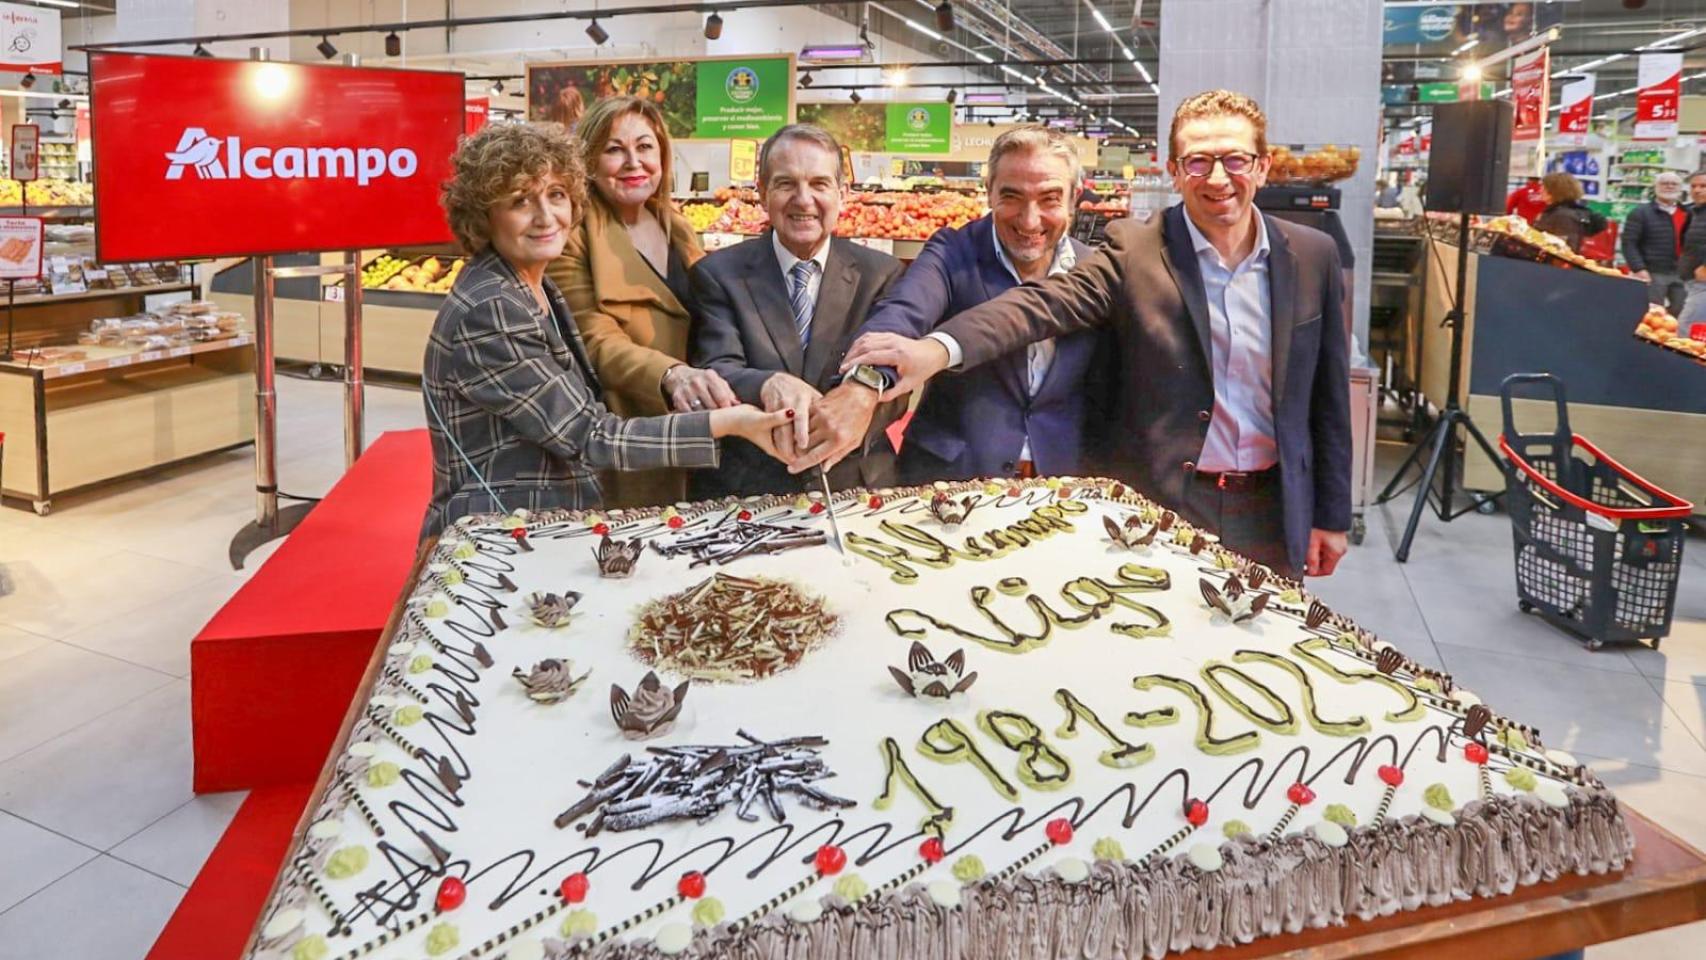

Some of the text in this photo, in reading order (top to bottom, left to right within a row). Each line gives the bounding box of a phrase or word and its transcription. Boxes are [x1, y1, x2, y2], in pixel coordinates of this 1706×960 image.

[164, 127, 418, 186] Alcampo
[885, 562, 1173, 654] Vigo
[872, 635, 1427, 838] 1981-2025
